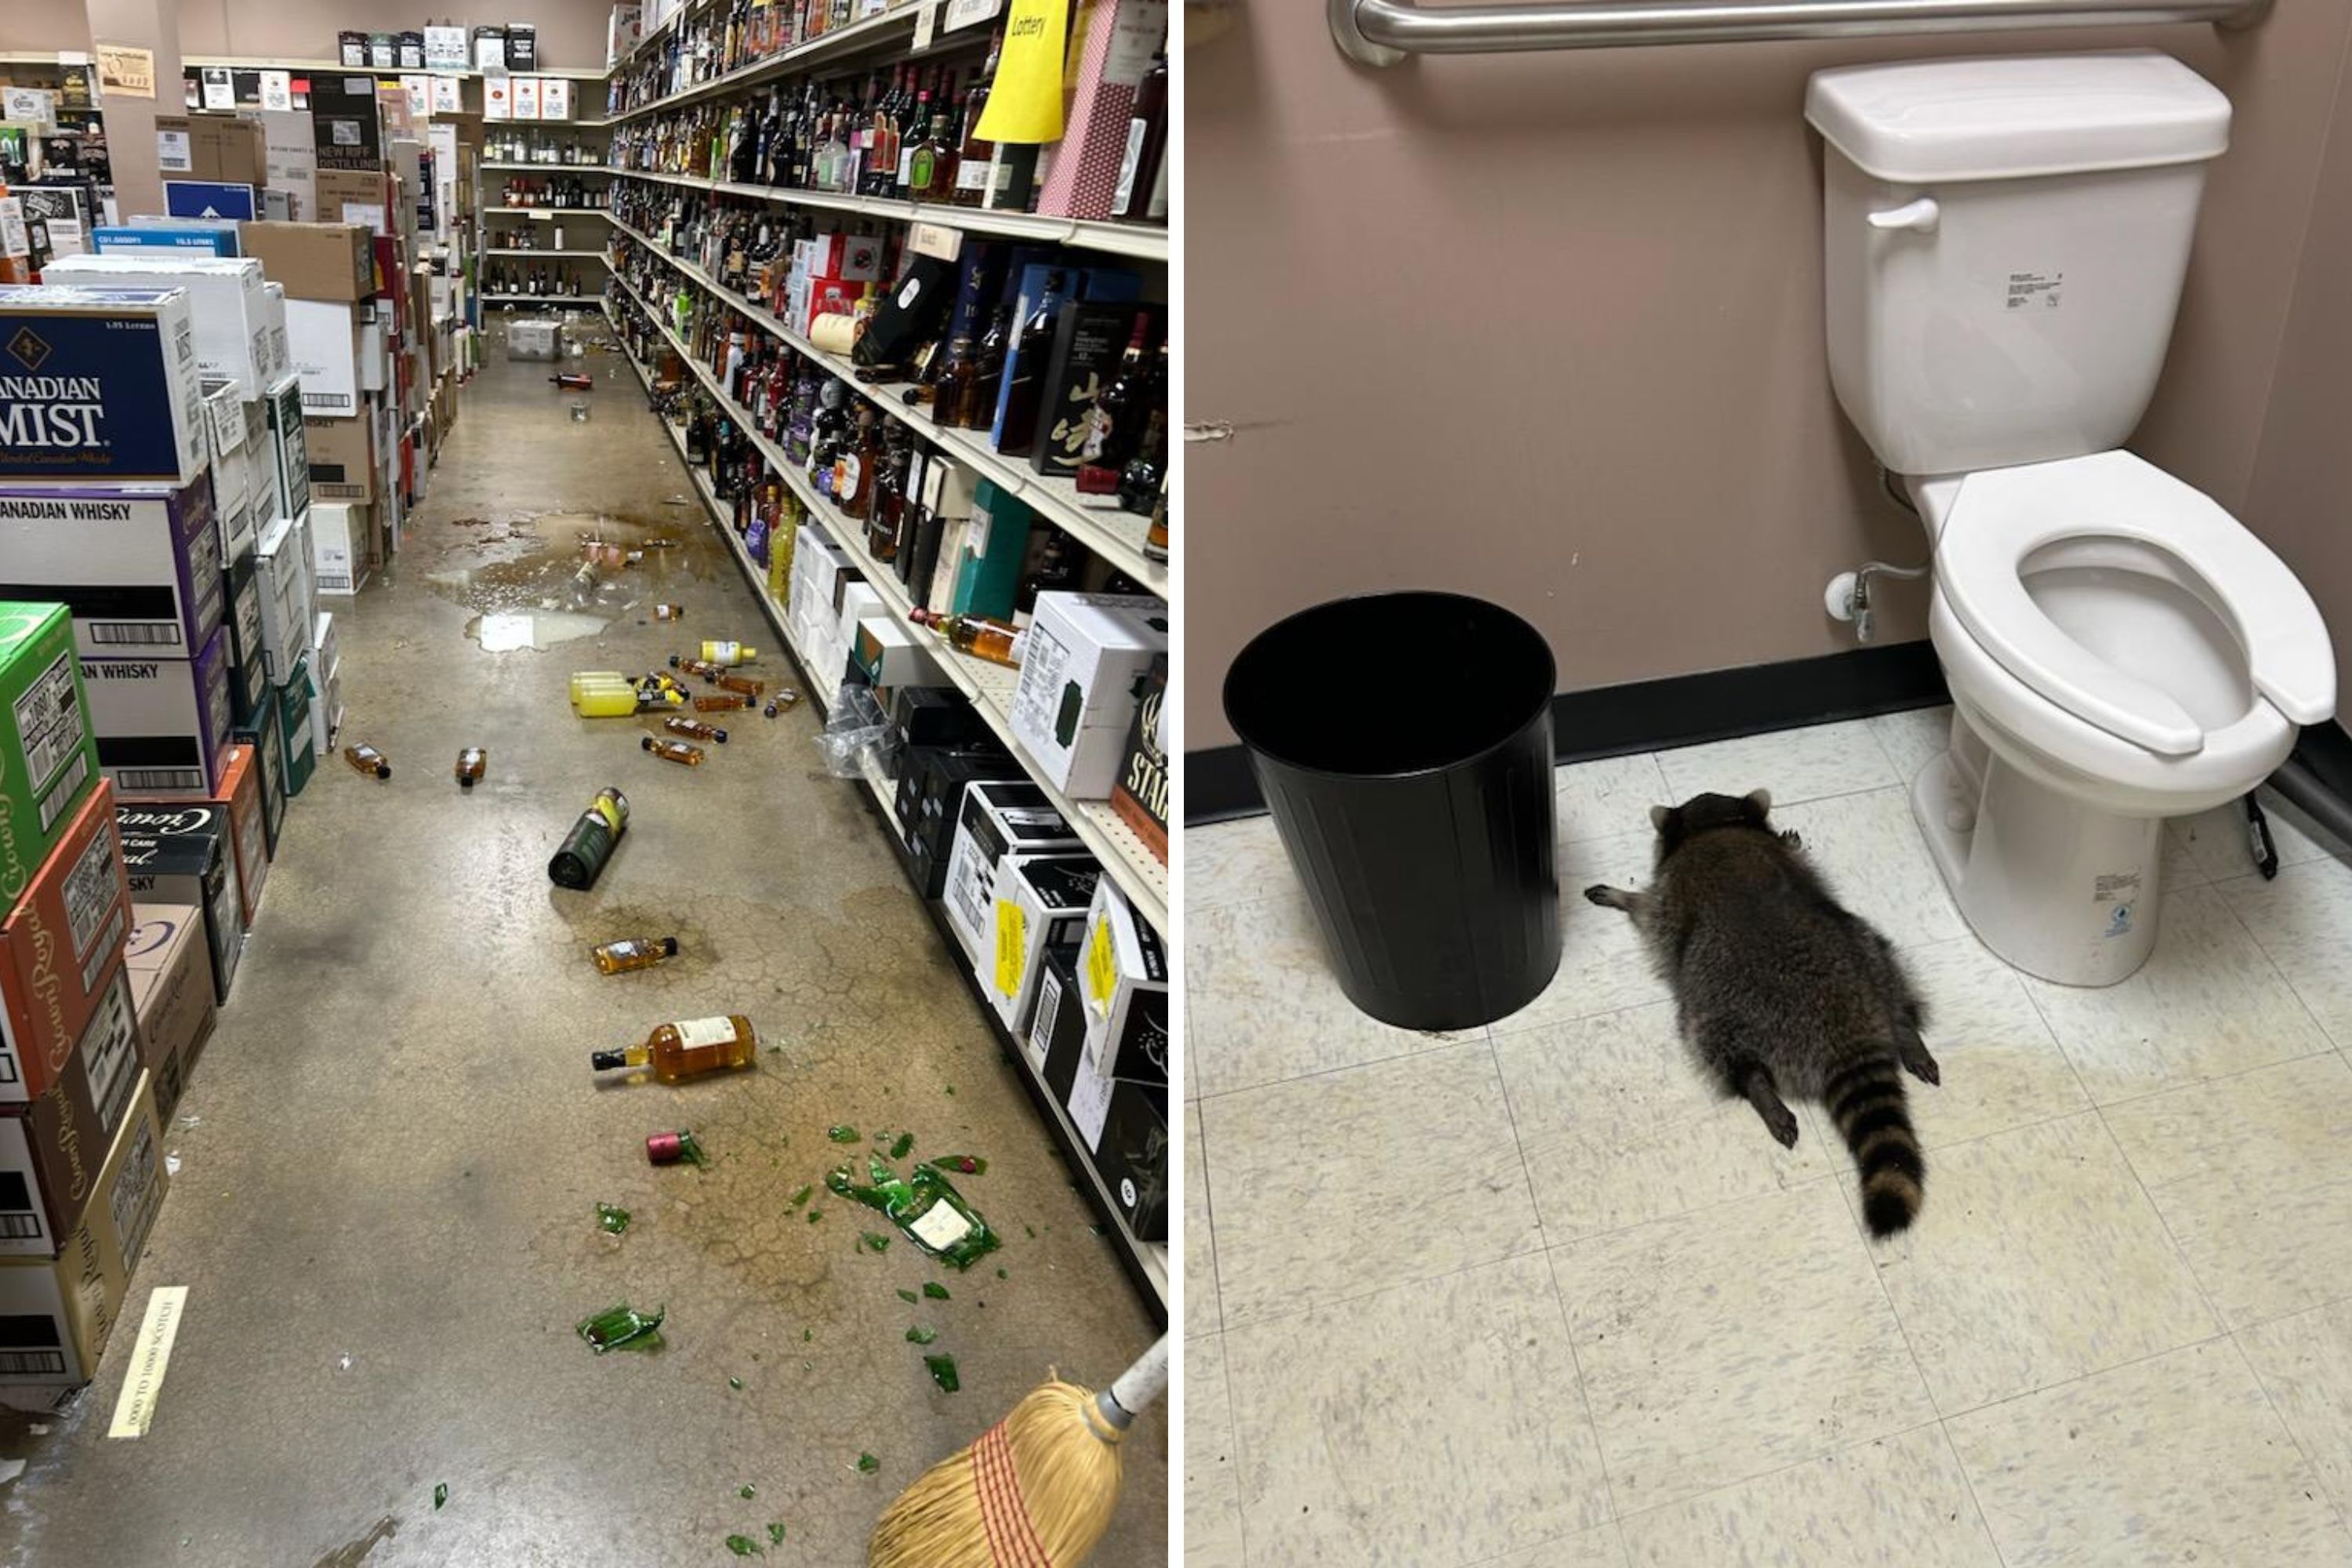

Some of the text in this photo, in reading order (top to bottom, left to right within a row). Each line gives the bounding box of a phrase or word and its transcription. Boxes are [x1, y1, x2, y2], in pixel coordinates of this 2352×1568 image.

[1011, 16, 1046, 39] Lottery
[0, 376, 101, 400] NADIAN
[0, 502, 131, 521] ANADIAN WHISKY
[101, 663, 158, 679] WHISKY
[128, 875, 155, 892] SKY
[151, 1301, 173, 1346] SCOTCH
